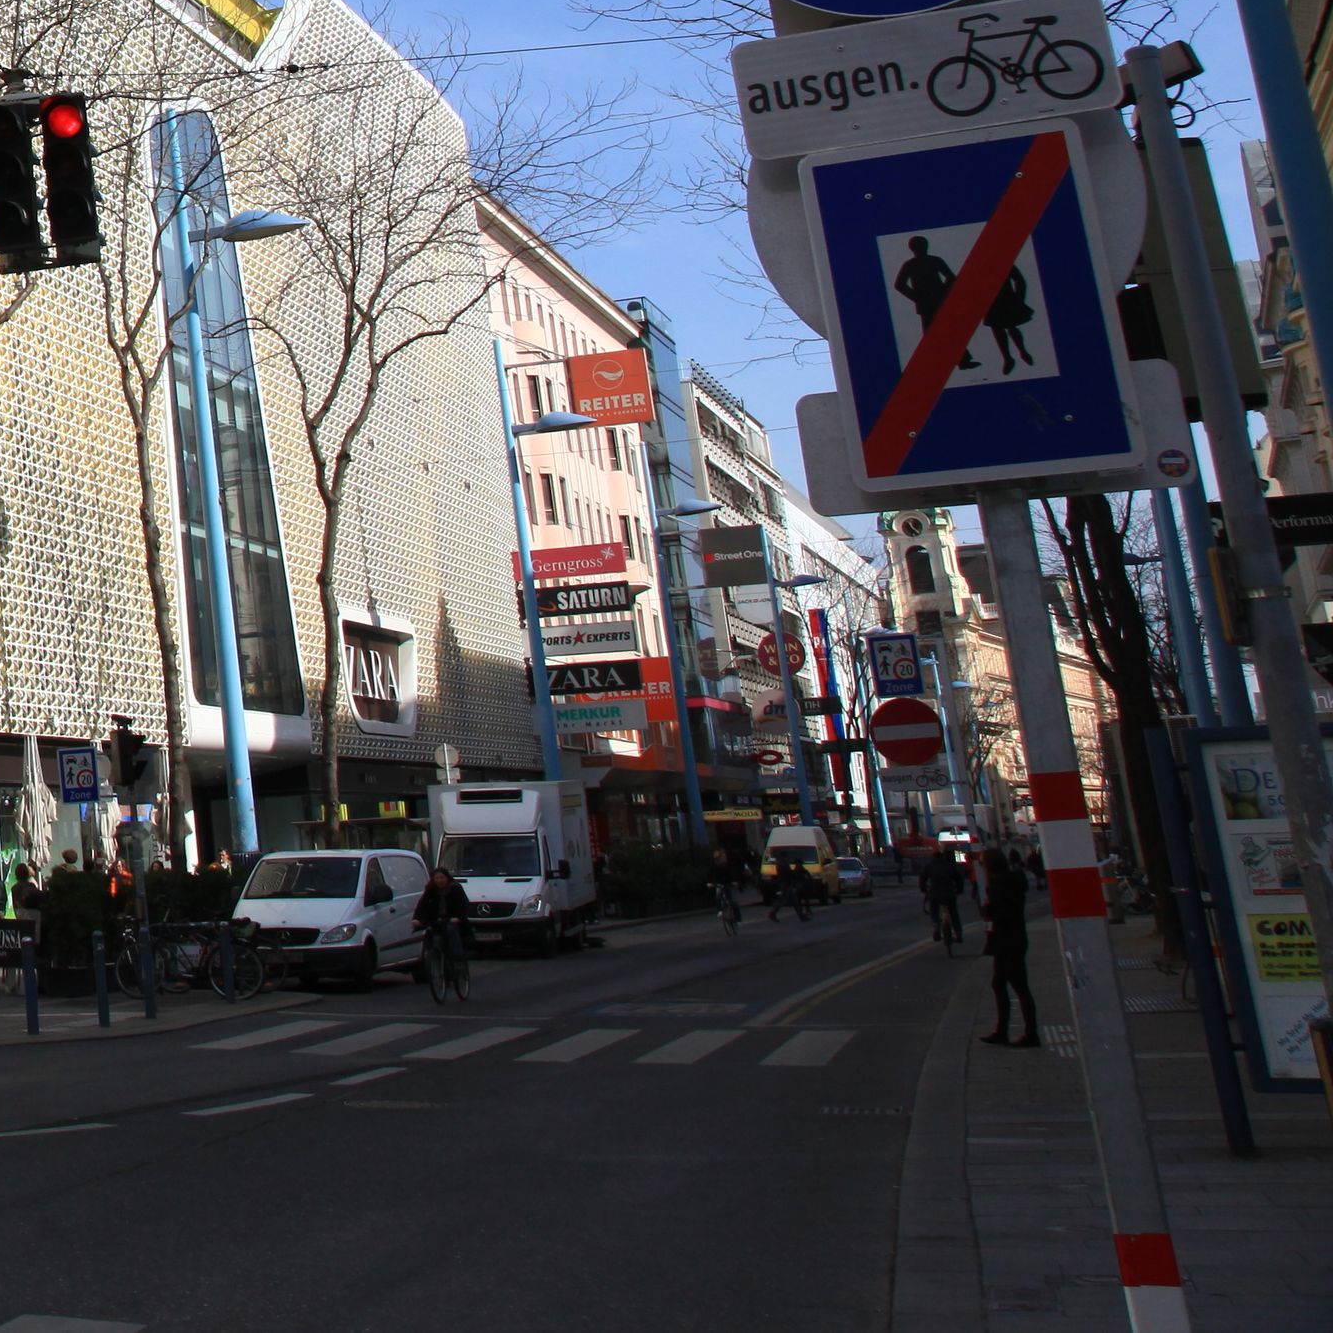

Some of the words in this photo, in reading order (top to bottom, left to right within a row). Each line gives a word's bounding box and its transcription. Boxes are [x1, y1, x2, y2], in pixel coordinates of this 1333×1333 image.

[746, 61, 920, 115] ausgen.
[579, 392, 646, 412] REITER
[714, 551, 744, 561] Street
[744, 550, 764, 559] One
[532, 558, 604, 573] Gerngross
[556, 586, 628, 610] SATURN
[542, 635, 572, 647] PORTS
[586, 632, 631, 643] EXPERTS
[764, 641, 798, 654] WIN
[900, 664, 913, 677] 20
[547, 667, 626, 690] ZARA
[885, 682, 915, 693] Zone
[556, 706, 622, 721] MERKUR
[81, 774, 92, 786] 20
[69, 790, 92, 801] Zone
